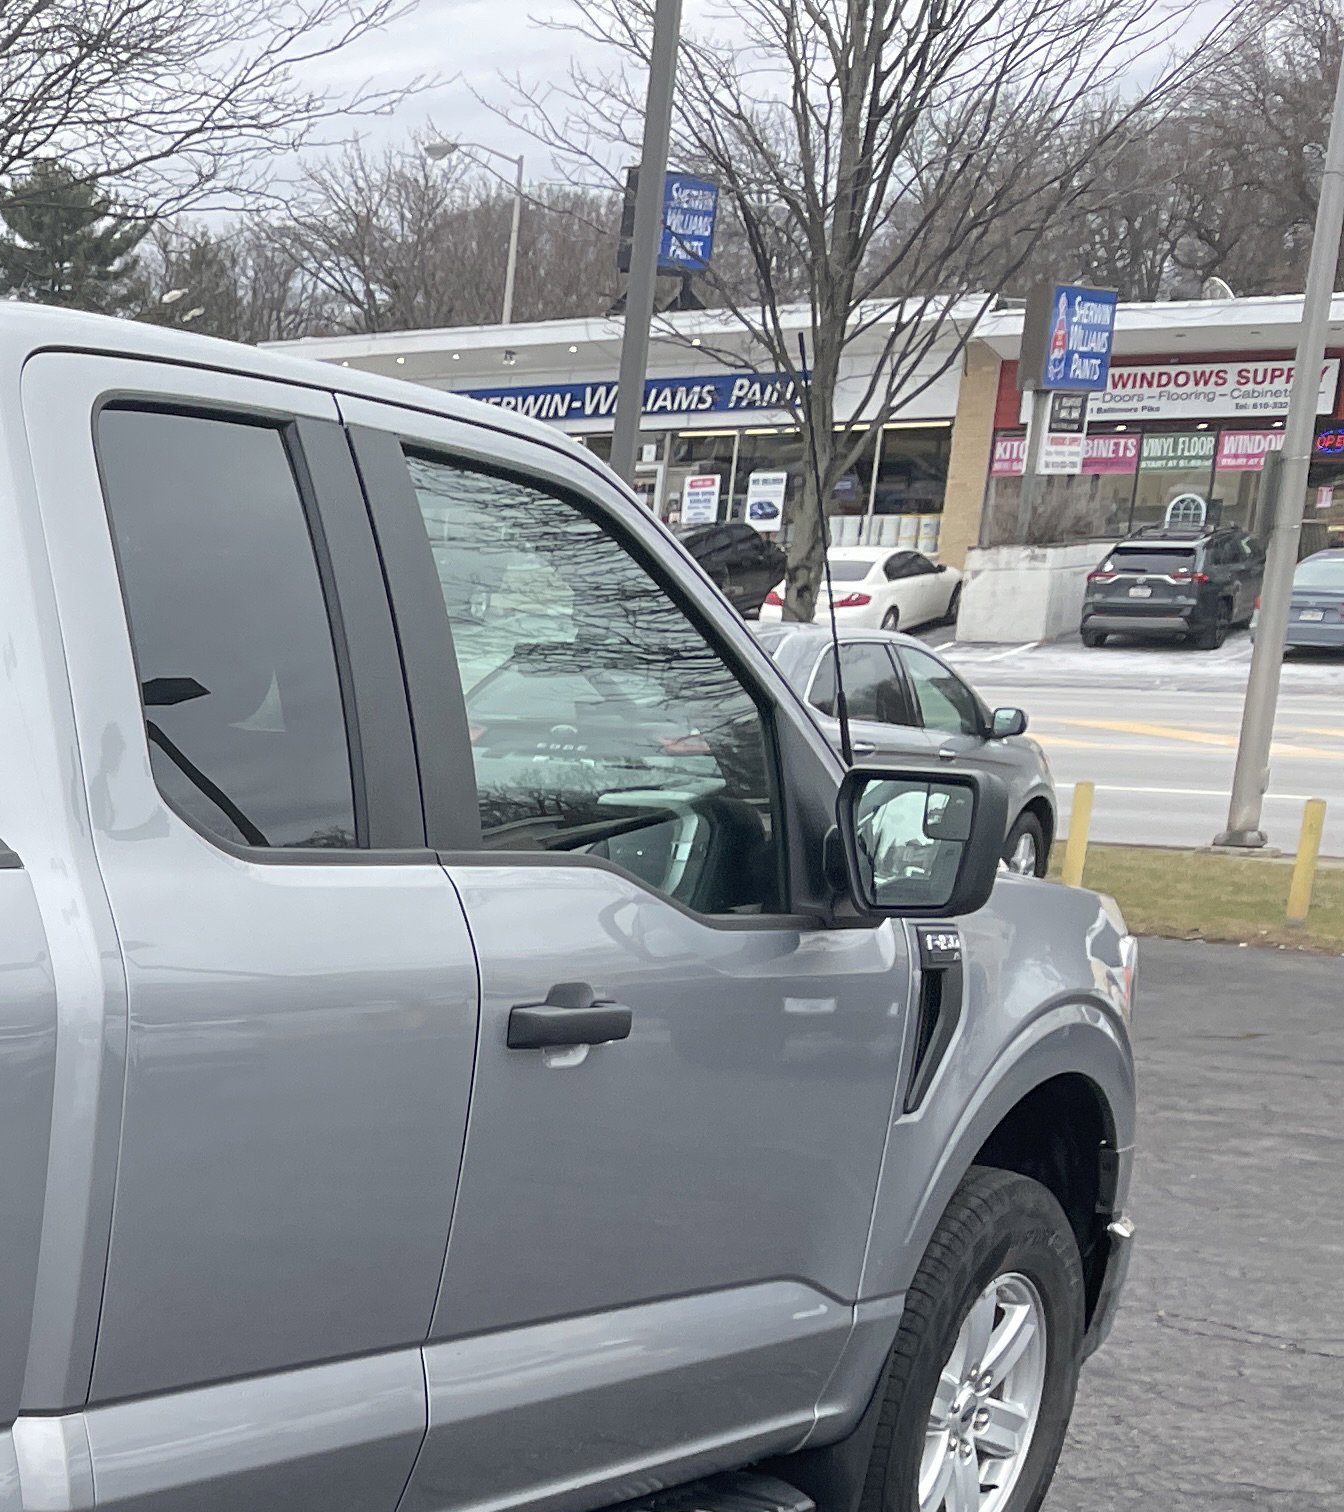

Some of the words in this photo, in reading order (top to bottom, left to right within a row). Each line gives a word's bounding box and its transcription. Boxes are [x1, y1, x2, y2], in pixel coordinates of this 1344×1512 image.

[1111, 368, 1229, 390] WINDOWS
[1102, 391, 1145, 404] Doors
[1158, 389, 1216, 402] Flooring
[1142, 436, 1177, 457] VINYL
[1178, 434, 1215, 457] FLOOR
[1317, 434, 1344, 449] OPE
